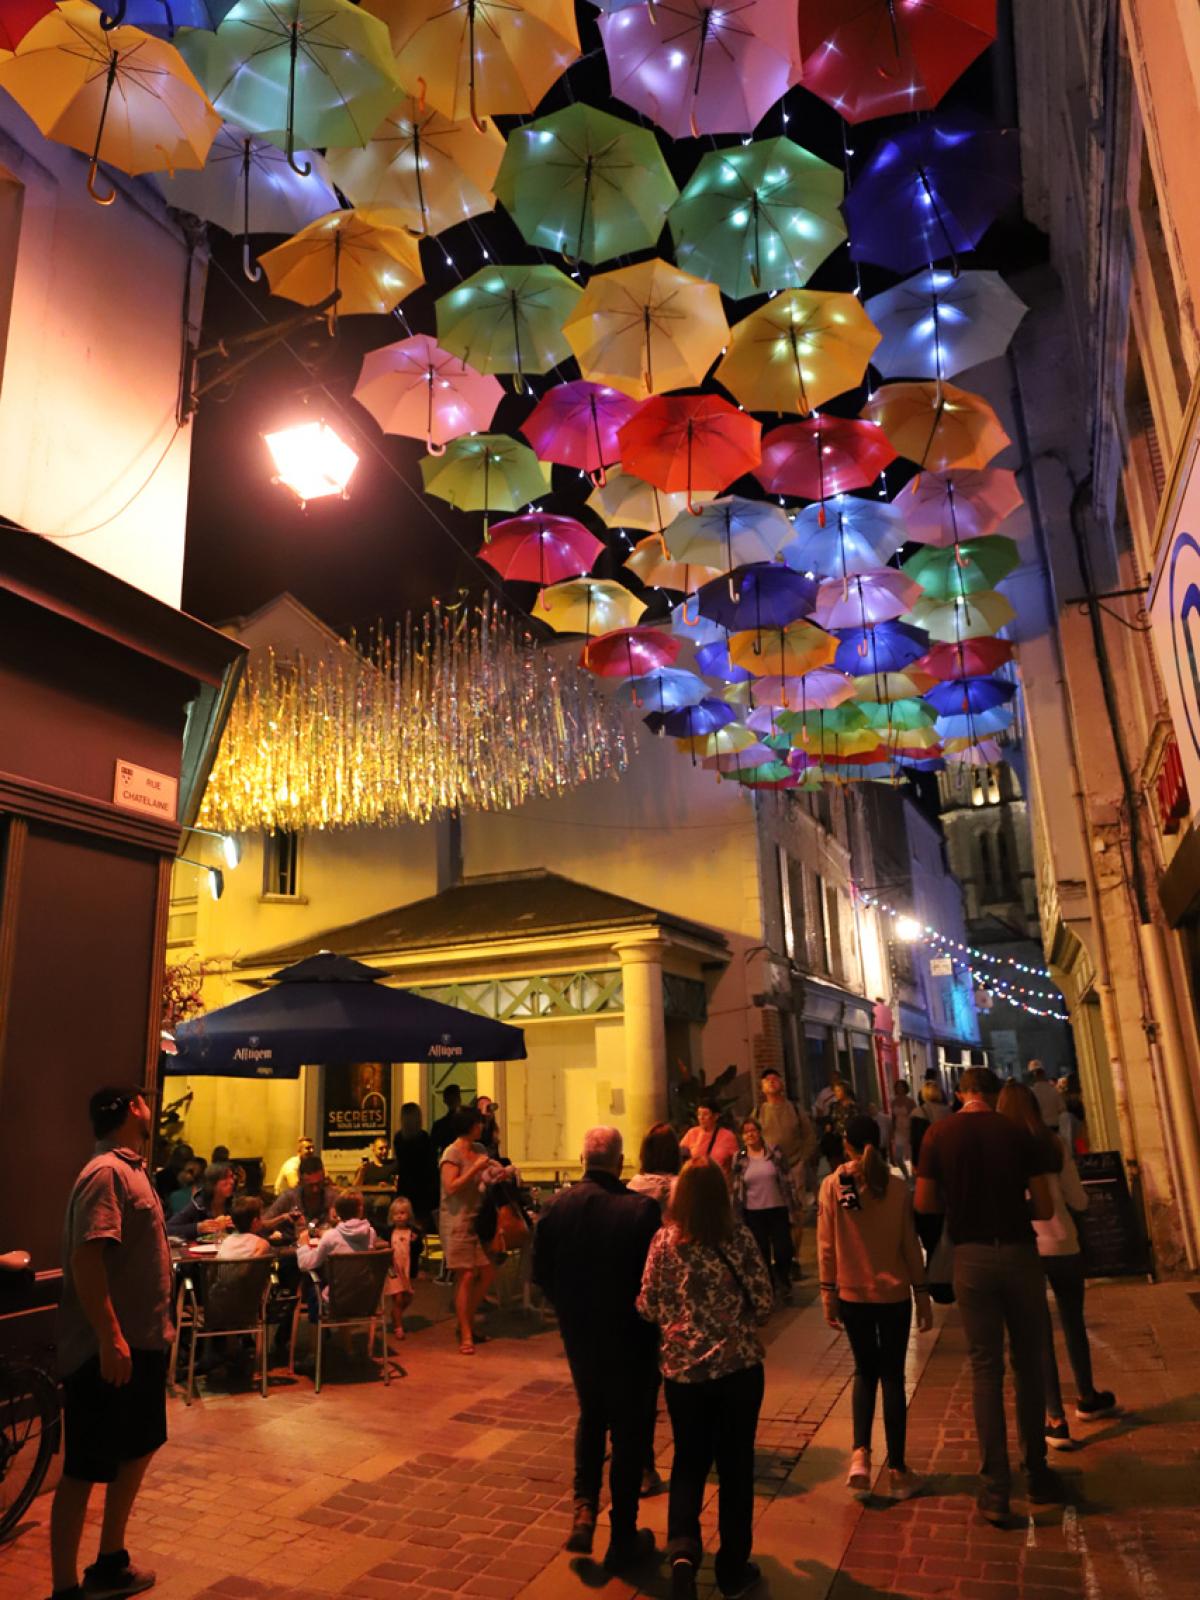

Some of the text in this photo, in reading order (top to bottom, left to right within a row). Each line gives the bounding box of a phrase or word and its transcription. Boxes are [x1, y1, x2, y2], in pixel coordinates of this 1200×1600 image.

[146, 778, 161, 790] RUE
[122, 790, 169, 811] CHATELAINE
[328, 1109, 382, 1123] SECRETS
